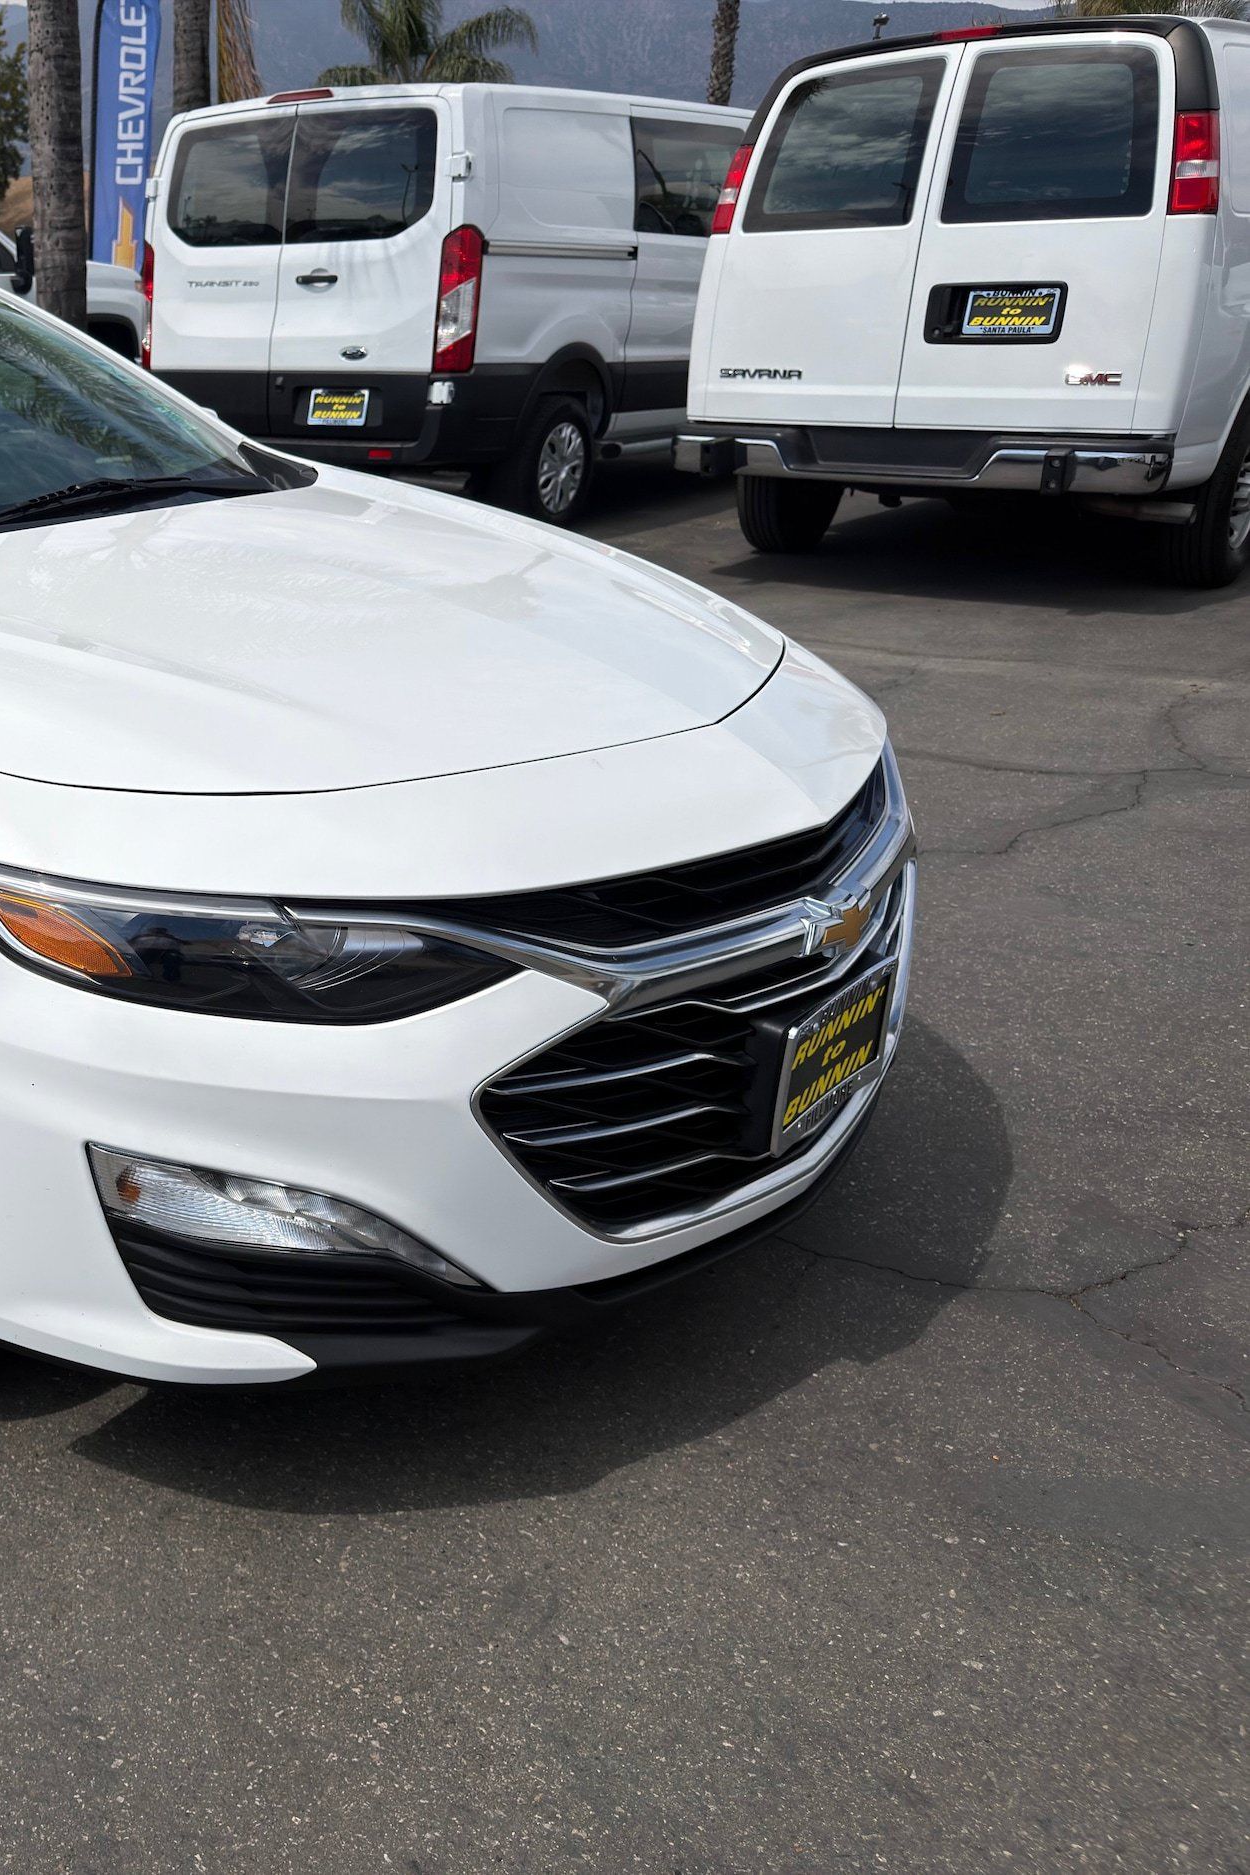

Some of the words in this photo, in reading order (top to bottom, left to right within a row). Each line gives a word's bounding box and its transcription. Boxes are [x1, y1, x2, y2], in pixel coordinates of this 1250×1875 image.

[115, 0, 147, 185] CHEVROLE
[187, 280, 241, 288] TRANSIT
[973, 297, 1053, 307] RUNNIN'
[1001, 307, 1022, 315] to
[969, 316, 1046, 326] BUNNIN
[719, 368, 803, 380] SAVANA
[1065, 369, 1123, 386] GMC
[315, 395, 364, 404] RUNNIN'
[332, 403, 346, 411] to
[312, 410, 361, 419] BUNNIN
[791, 985, 886, 1071] RUNNIN'
[821, 1040, 847, 1067] to
[782, 1039, 873, 1127] BUNNIN
